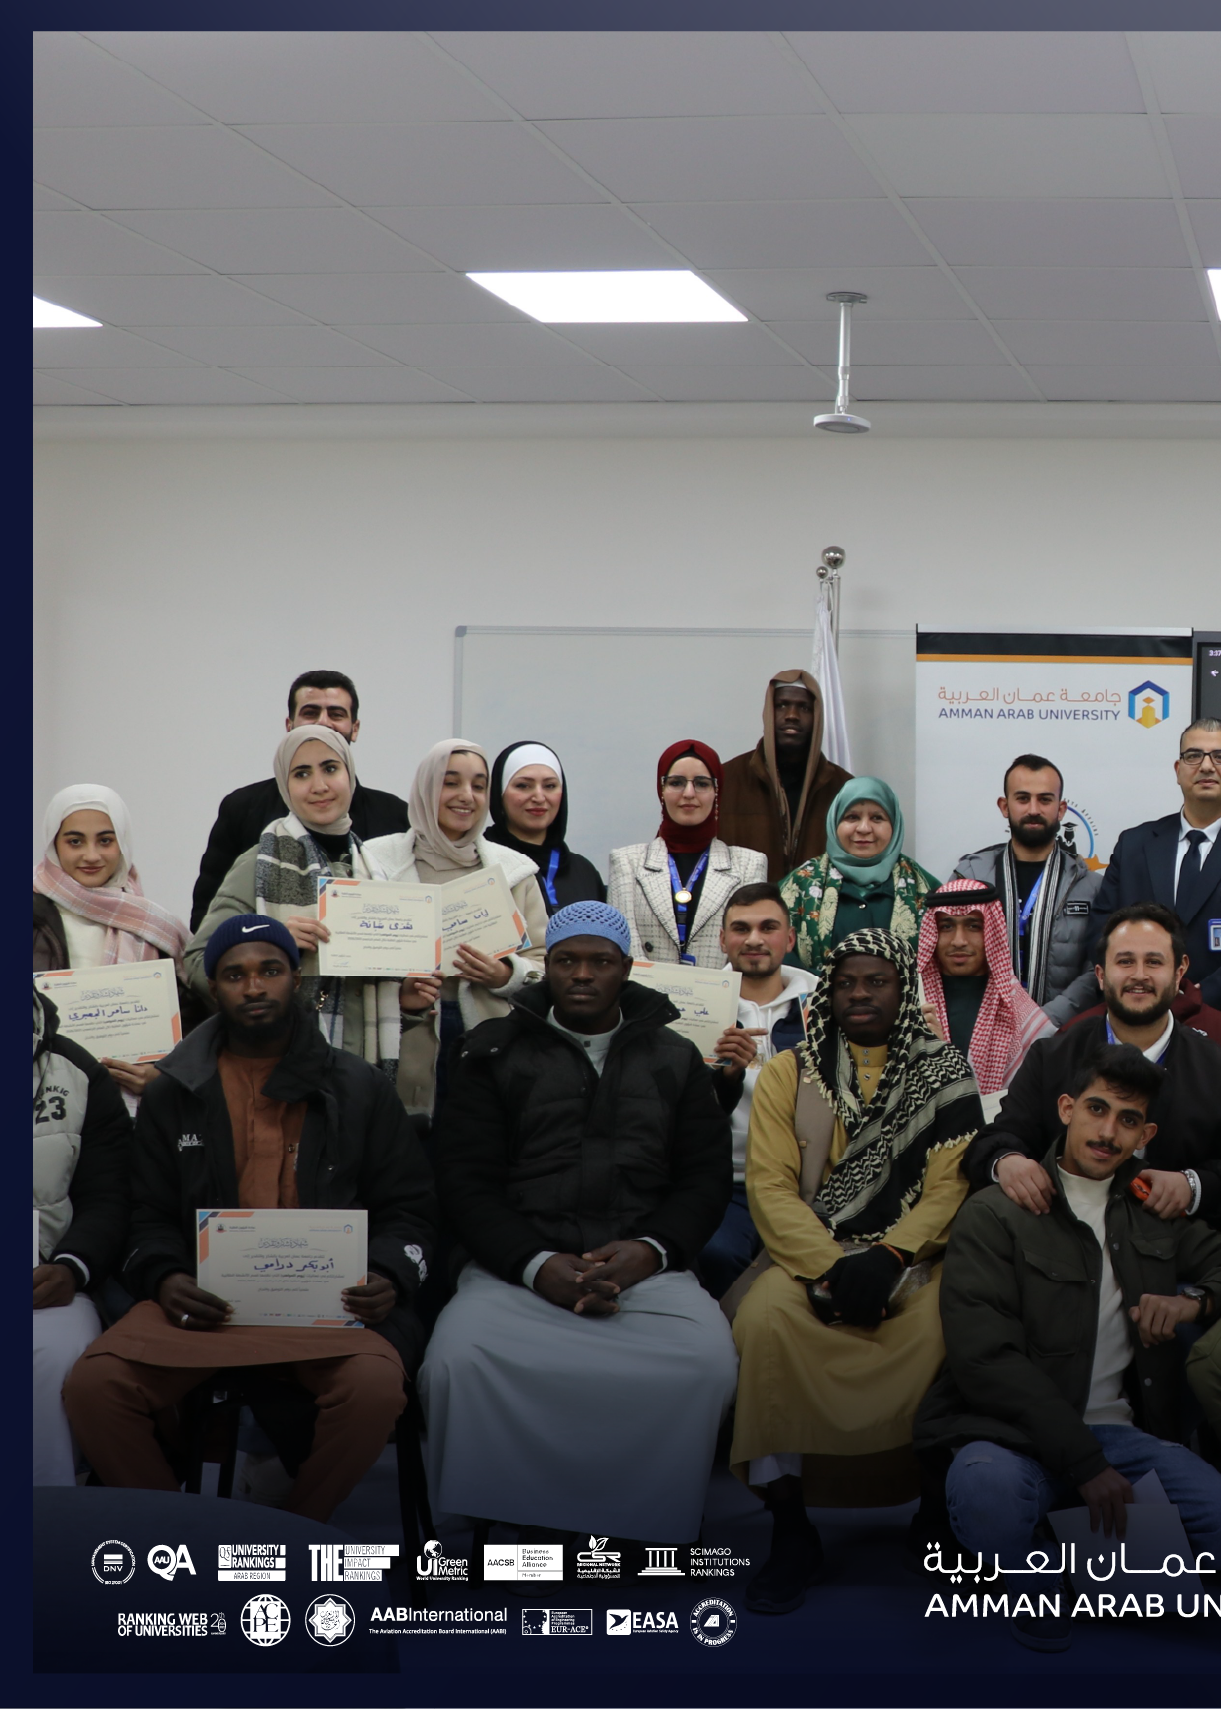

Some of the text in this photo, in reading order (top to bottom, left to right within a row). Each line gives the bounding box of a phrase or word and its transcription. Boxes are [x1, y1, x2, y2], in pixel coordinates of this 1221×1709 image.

[937, 686, 1122, 707] جامعة عمان العربية
[938, 707, 1121, 721] AMMAN ARAB UNIVERSITY
[35, 1096, 67, 1125] 23
